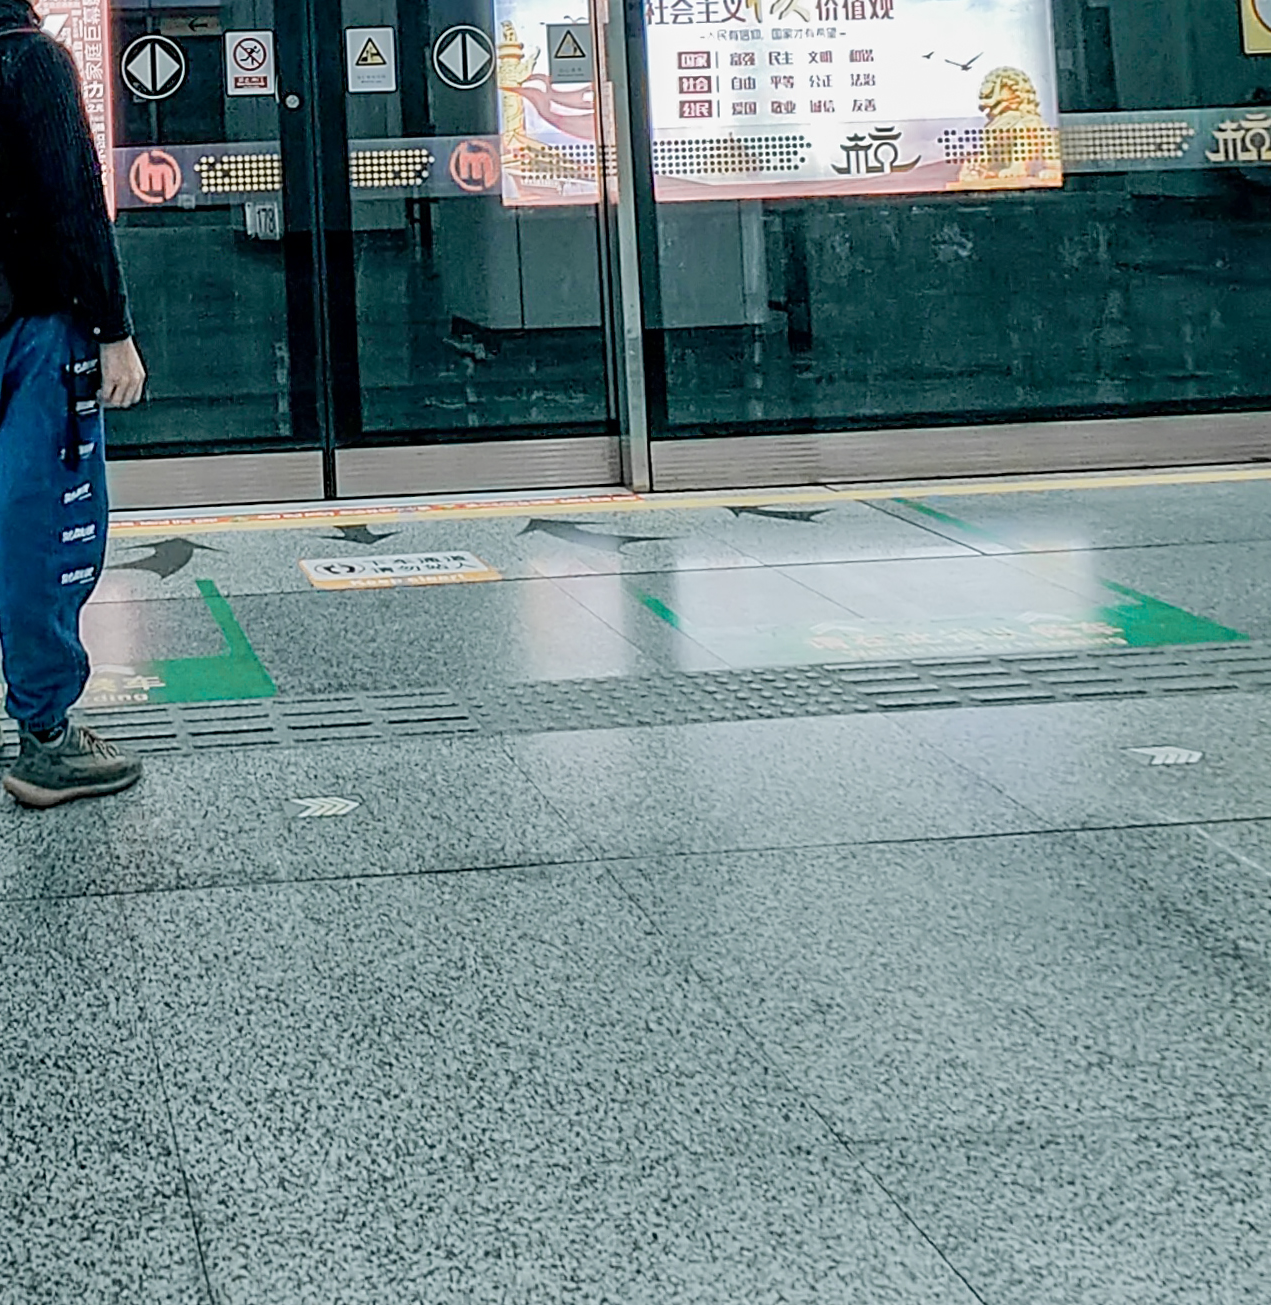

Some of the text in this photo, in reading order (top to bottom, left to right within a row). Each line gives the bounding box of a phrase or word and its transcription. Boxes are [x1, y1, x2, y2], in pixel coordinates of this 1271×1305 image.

[680, 53, 708, 68] 国家
[768, 51, 794, 66] 民主
[808, 50, 833, 64] 文明
[731, 76, 757, 91] 自由
[770, 75, 795, 90] 平等
[809, 74, 833, 88] 公正
[682, 102, 710, 117] 公民
